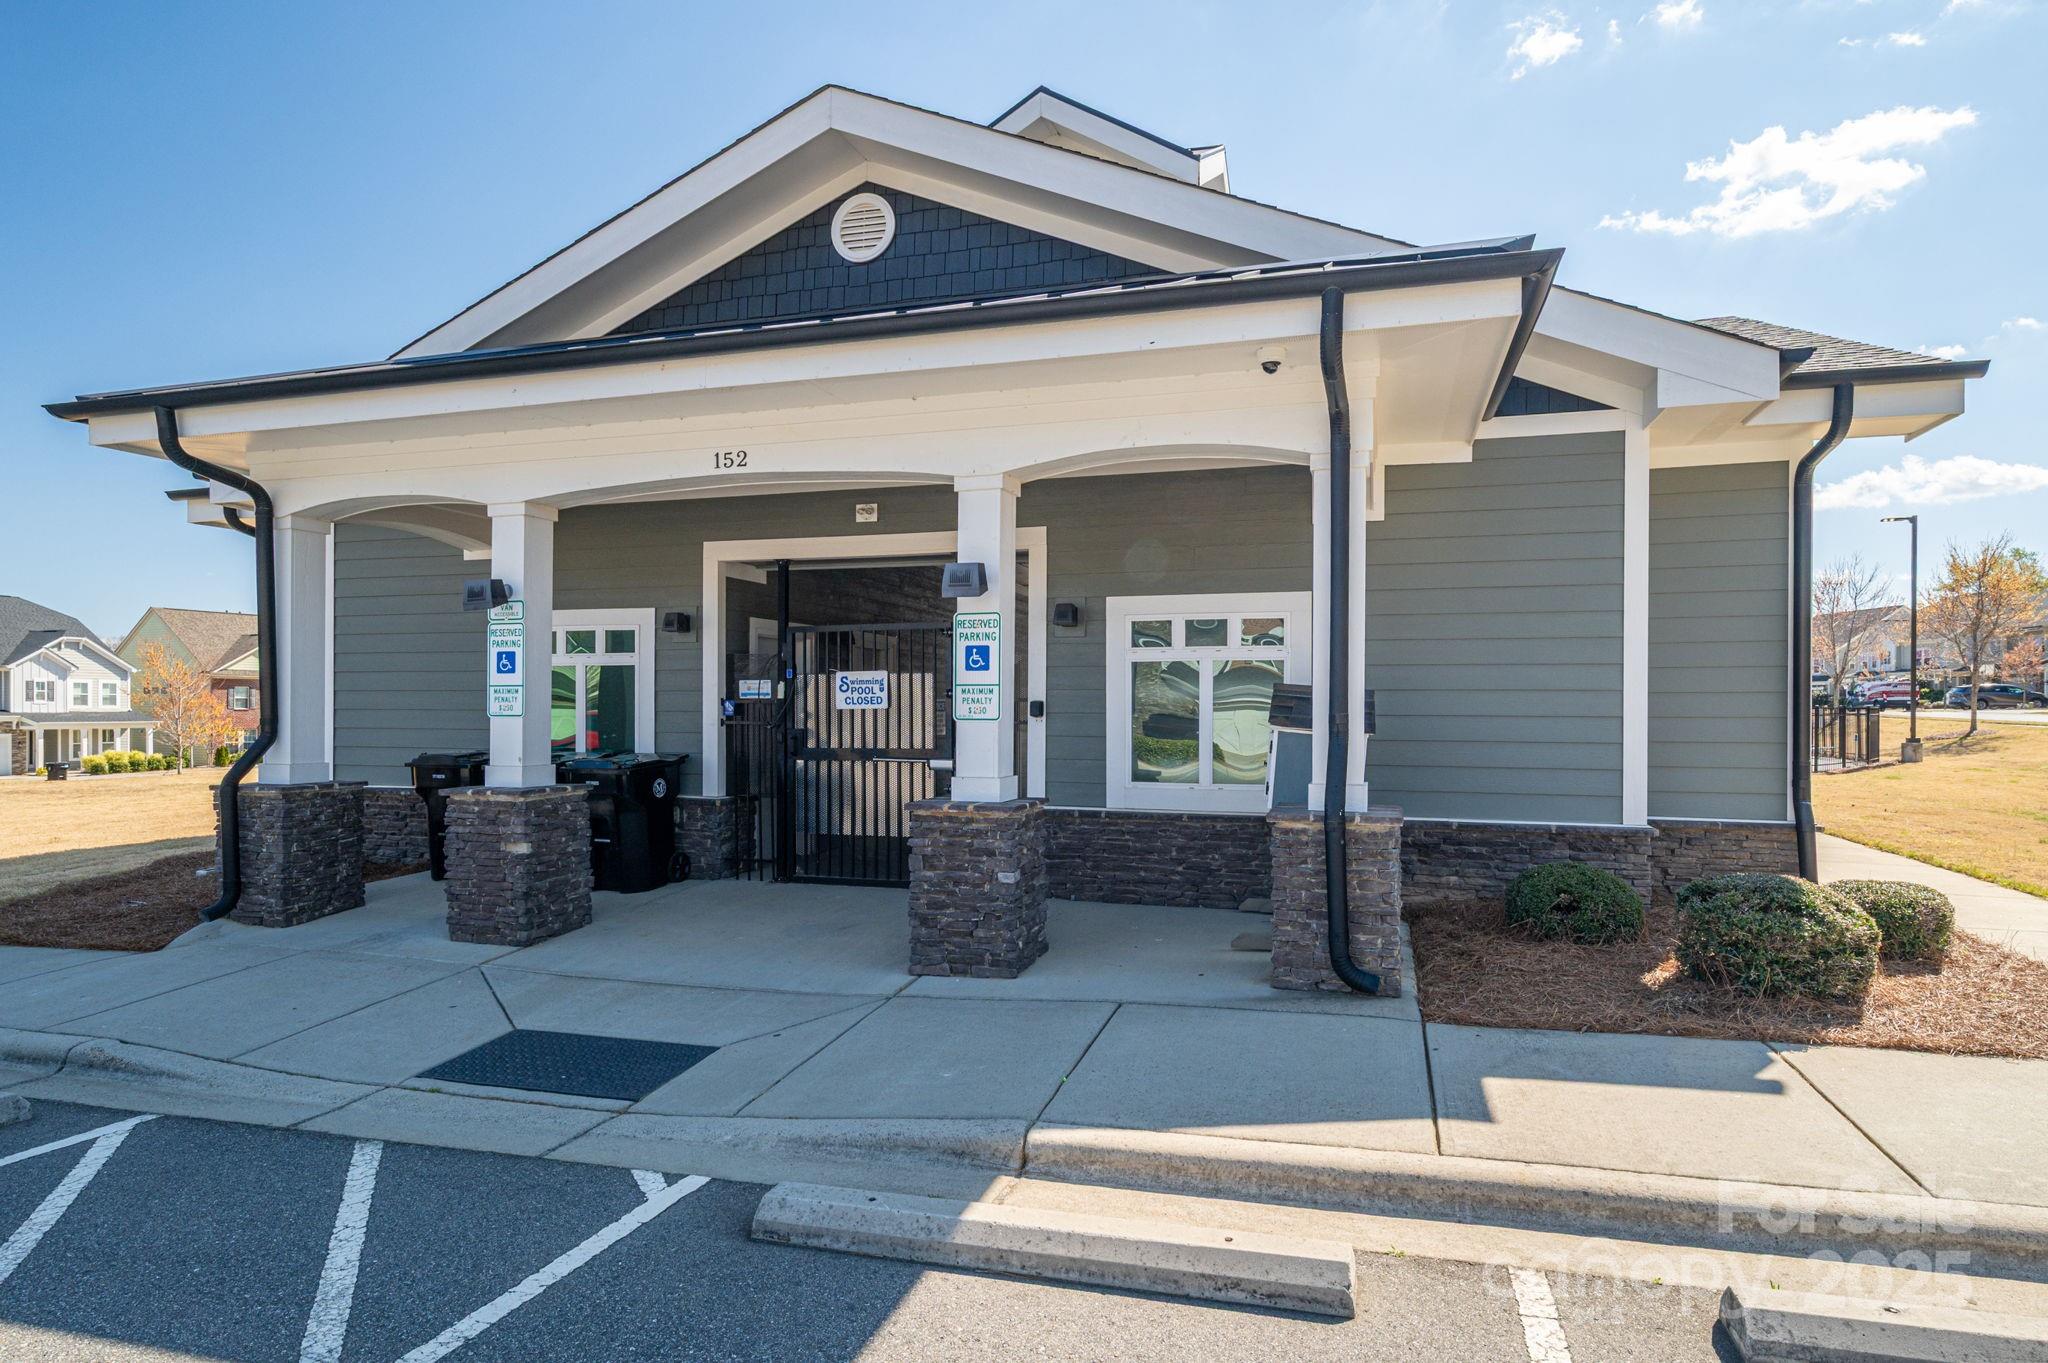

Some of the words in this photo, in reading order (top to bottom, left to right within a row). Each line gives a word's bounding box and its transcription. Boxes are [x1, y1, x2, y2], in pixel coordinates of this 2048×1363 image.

[713, 450, 748, 469] 152
[957, 618, 999, 629] RESERVED
[490, 628, 522, 637] RESERVED
[959, 631, 997, 642] PARKING
[491, 639, 521, 648] PARKING
[838, 675, 885, 693] Swimming
[493, 687, 519, 695] MAXIMUM
[850, 686, 876, 695] POOL
[961, 687, 994, 695] MAXIMUM
[844, 696, 883, 705] CLOSED
